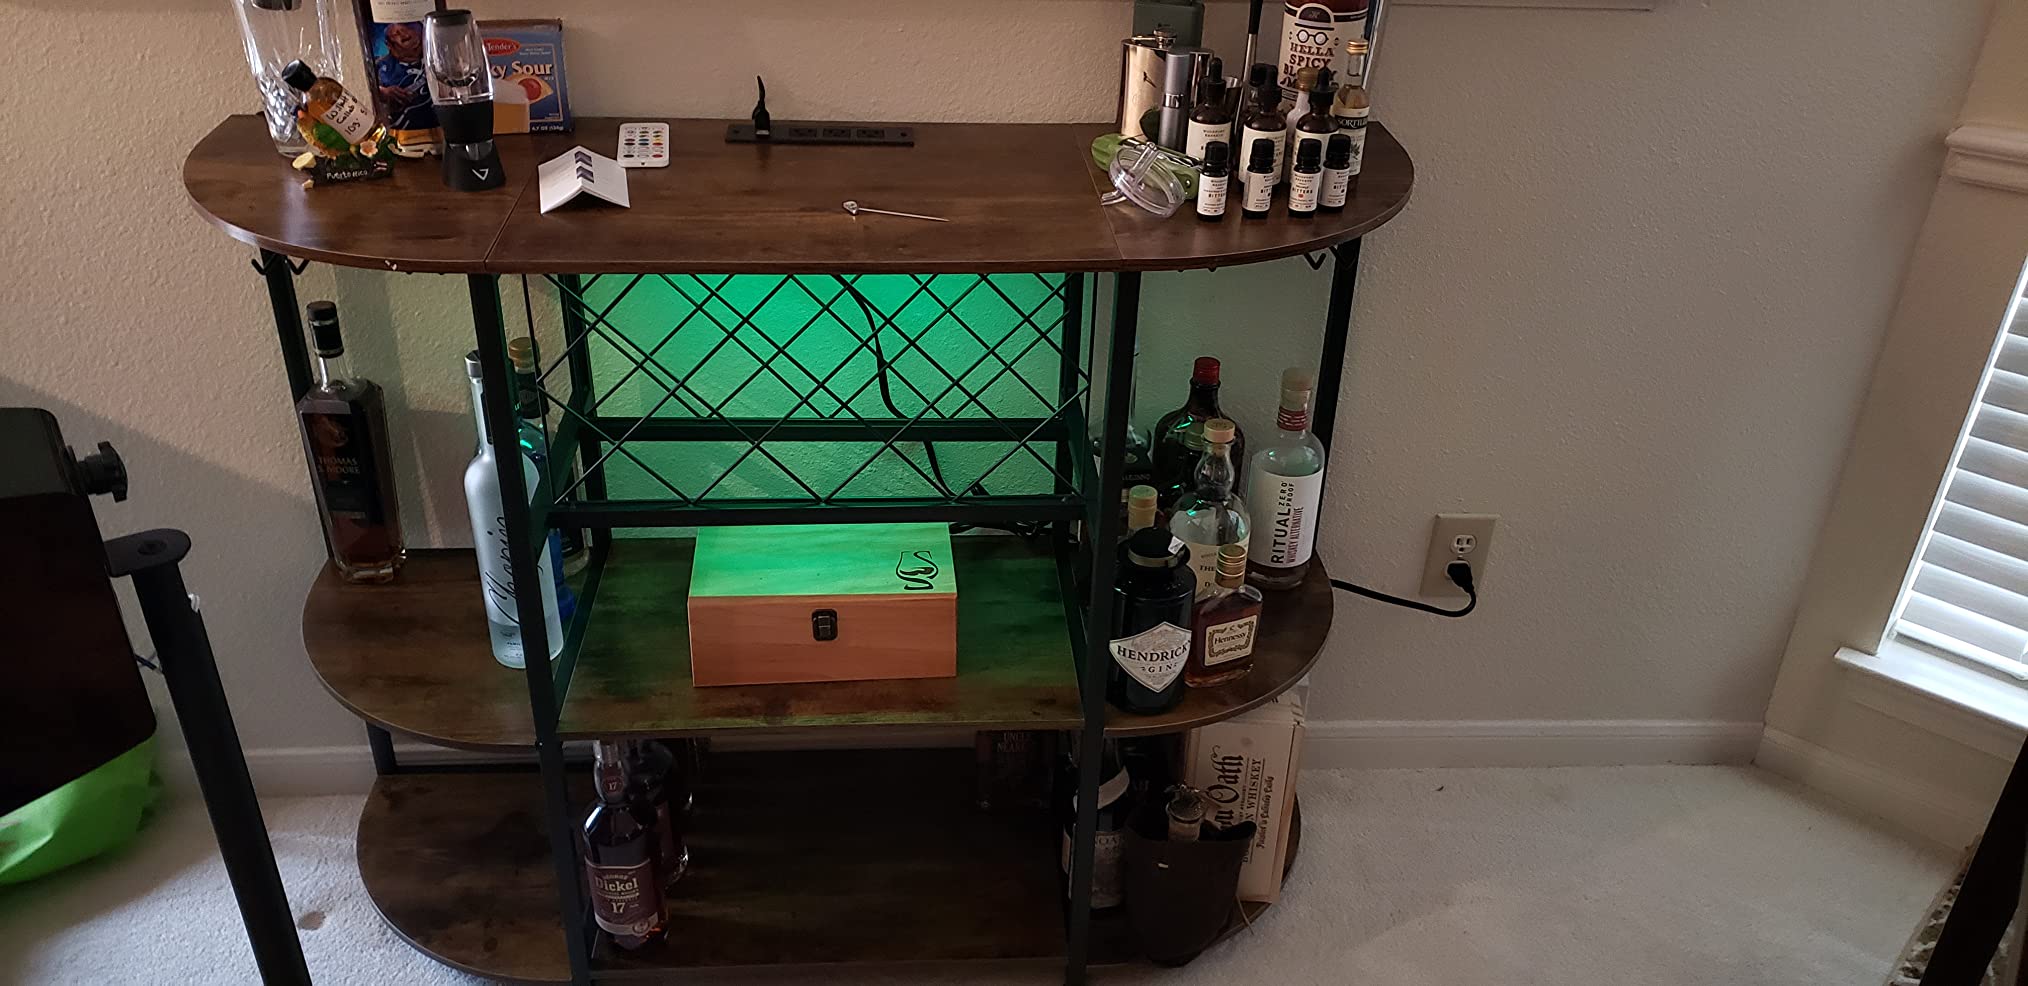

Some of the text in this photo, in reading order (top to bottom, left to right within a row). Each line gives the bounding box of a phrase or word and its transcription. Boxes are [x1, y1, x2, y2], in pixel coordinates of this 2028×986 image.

[1290, 42, 1335, 57] HELLA
[511, 60, 553, 76] Sour
[1289, 53, 1331, 69] SPICY
[1286, 482, 1295, 507] PROOF
[1270, 481, 1292, 564] RITUAL ZERO
[1214, 631, 1247, 645] Hennessy
[1148, 663, 1173, 674] GIN
[1205, 744, 1245, 804] Oath
[1246, 758, 1261, 809] WHISKEY
[594, 876, 639, 892] Dickel
[610, 902, 626, 914] 17
